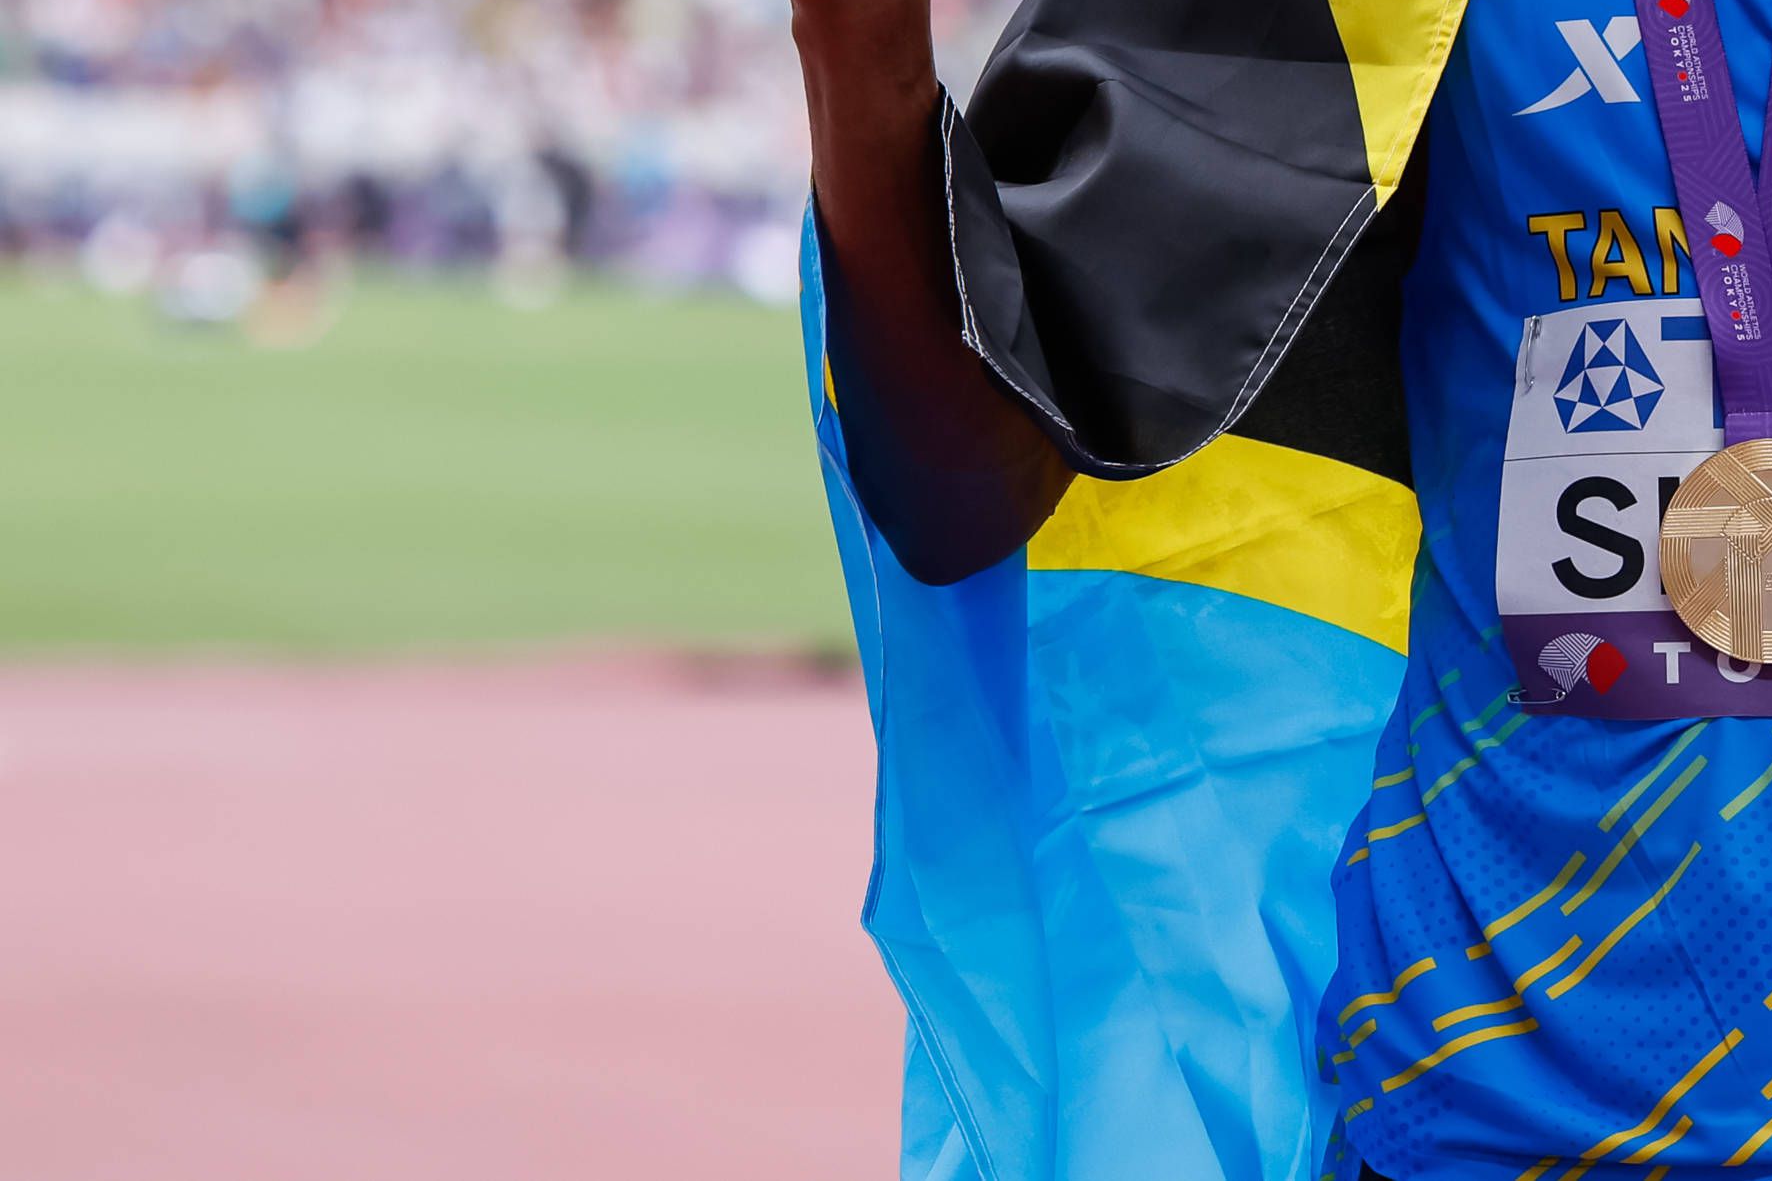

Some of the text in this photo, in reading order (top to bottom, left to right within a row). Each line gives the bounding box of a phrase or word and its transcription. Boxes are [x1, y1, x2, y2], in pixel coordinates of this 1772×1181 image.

[1677, 25, 1701, 101] CHAMPIONSHIPS
[1686, 24, 1709, 100] WORLD ATHLETICS
[1730, 264, 1753, 341] CHAMPIONSHIPS
[1739, 264, 1762, 340] WORLD ATHLETICS
